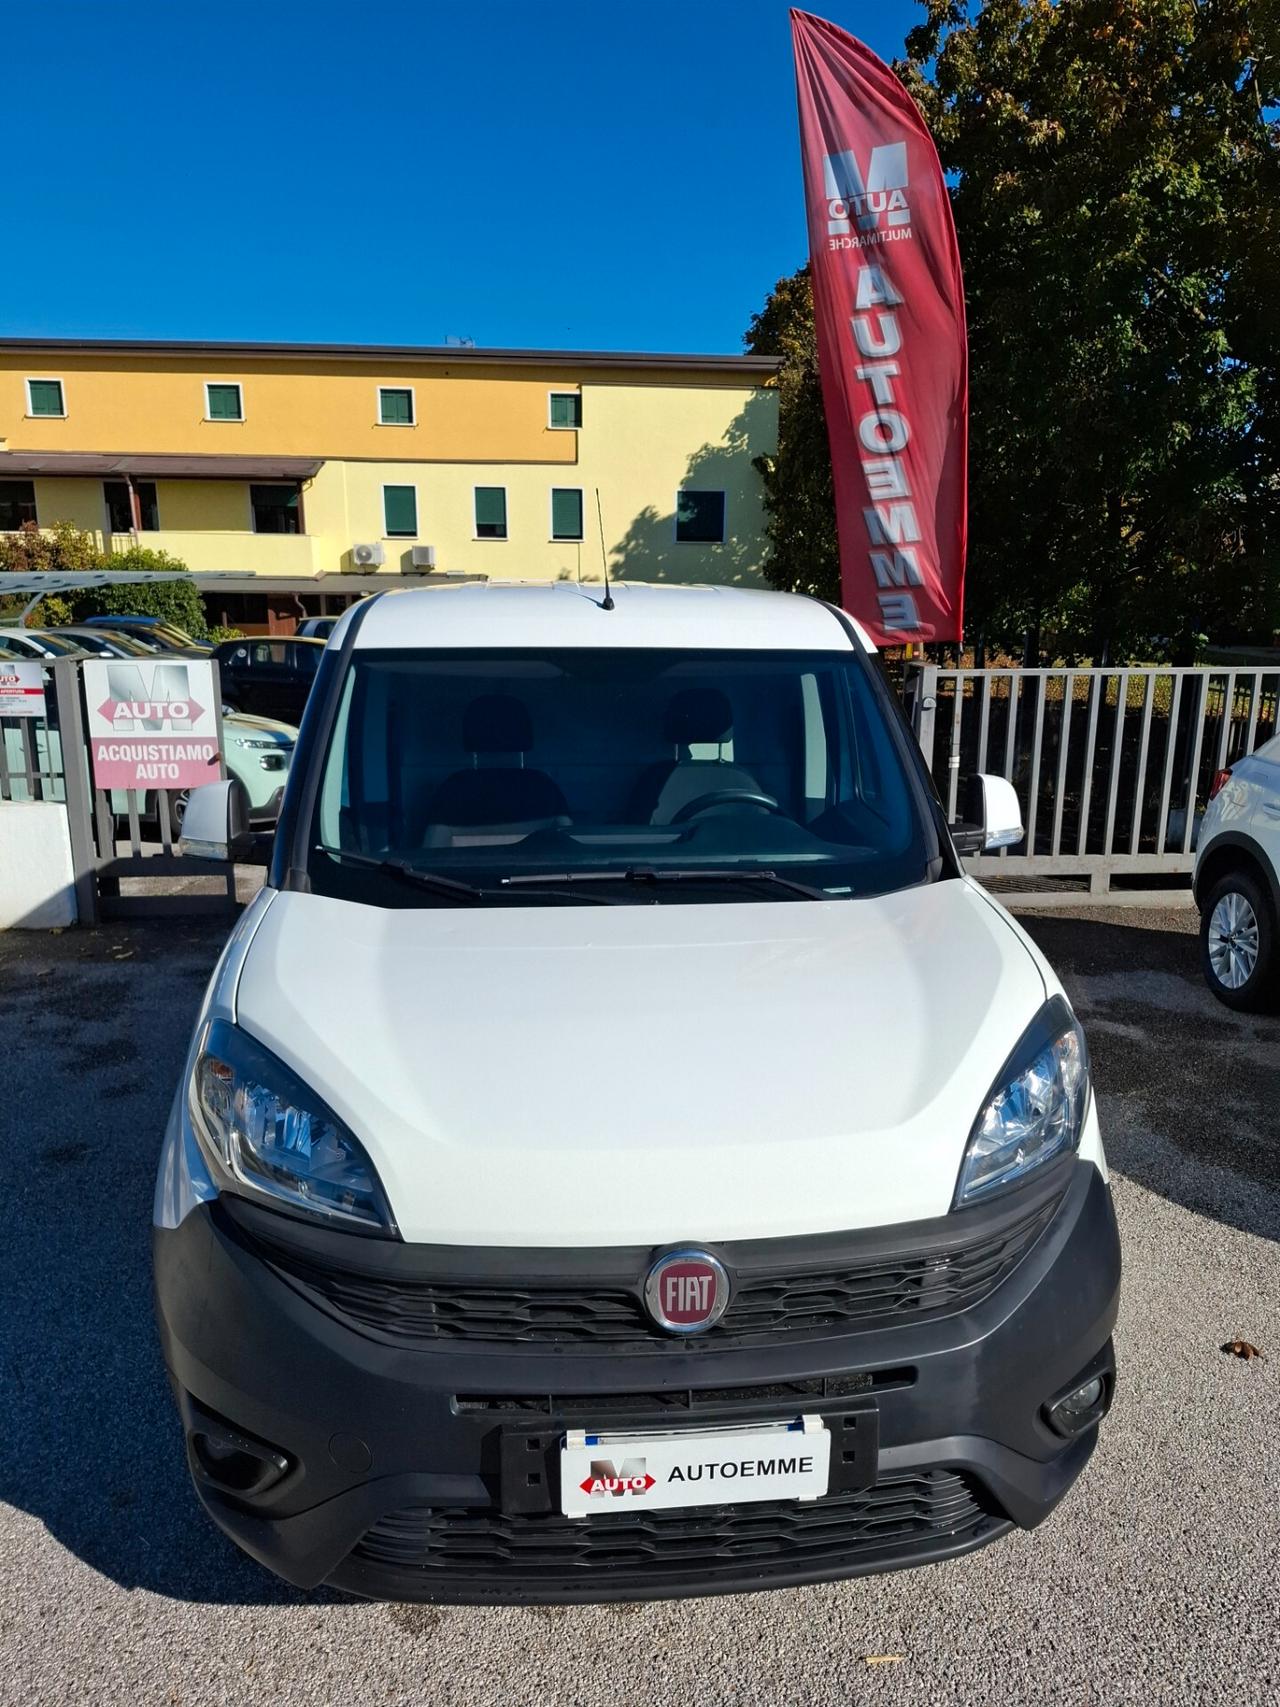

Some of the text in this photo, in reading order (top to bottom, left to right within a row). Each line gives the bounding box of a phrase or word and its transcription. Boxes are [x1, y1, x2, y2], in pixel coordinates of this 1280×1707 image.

[113, 701, 190, 720] AUTO
[97, 743, 215, 763] ACQUISTIAMO
[135, 762, 180, 781] AUTO
[666, 1275, 713, 1312] FIAT
[590, 1456, 814, 1492] AUTO AUTOEMME
